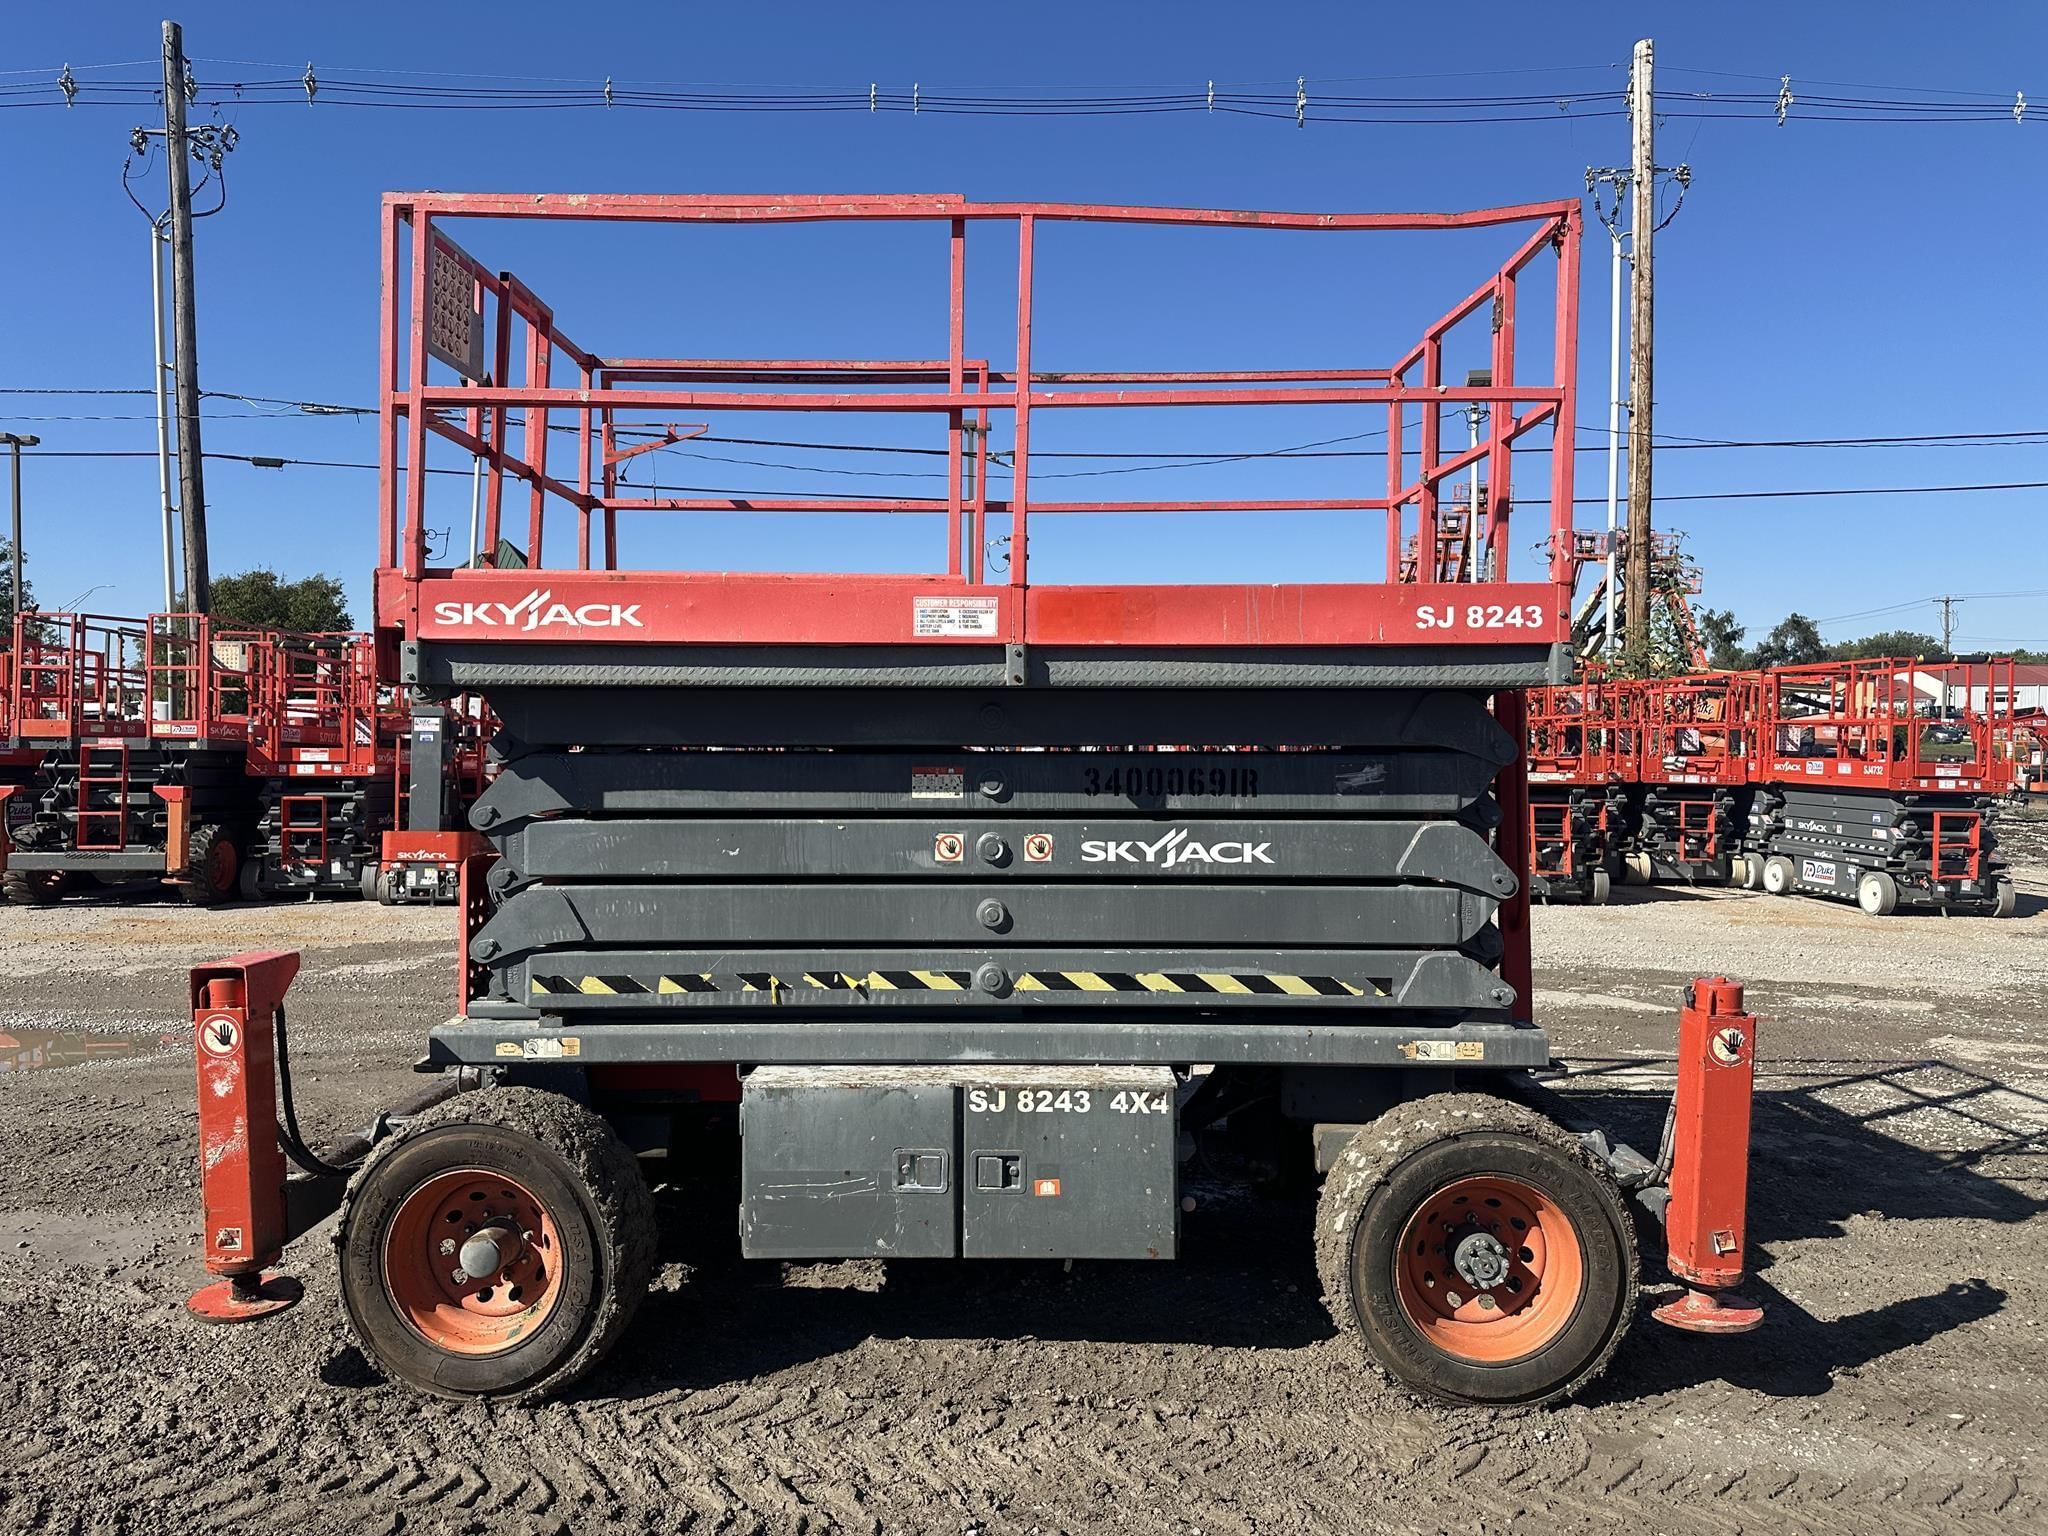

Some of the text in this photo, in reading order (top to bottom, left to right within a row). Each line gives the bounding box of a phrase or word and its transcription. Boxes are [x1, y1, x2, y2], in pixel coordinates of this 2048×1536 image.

[434, 588, 645, 631] SKYJACK
[1415, 605, 1543, 630] SJ 8243
[210, 725, 240, 737] SKYJACK
[1773, 761, 1801, 772] SKYJACK
[1797, 820, 1828, 833] SKYJACK
[397, 850, 448, 860] SKYJACK
[1081, 828, 1275, 868] SKYJACK
[969, 1090, 1169, 1114] SJ 8243 4X4
